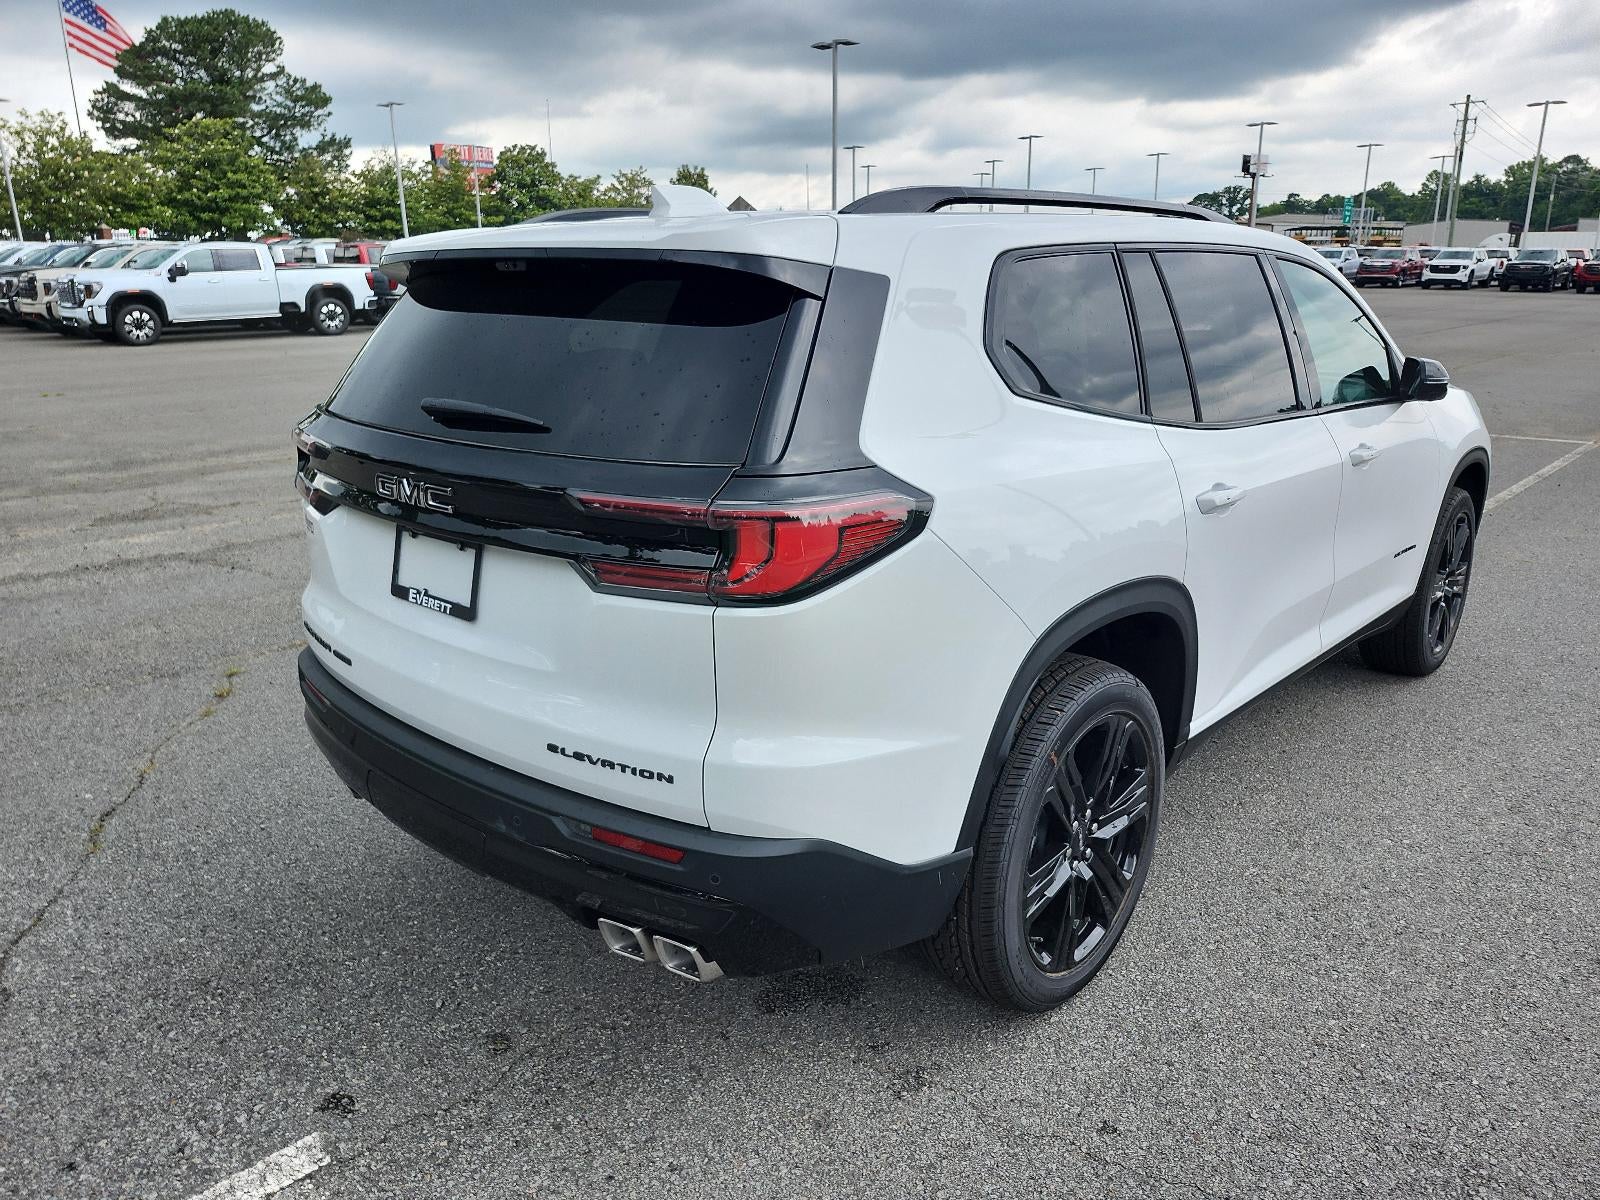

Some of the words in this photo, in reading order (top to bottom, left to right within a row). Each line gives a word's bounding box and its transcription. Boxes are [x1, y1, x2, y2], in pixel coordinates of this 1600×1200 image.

[375, 473, 453, 514] GMC
[408, 588, 453, 615] EVERETT
[546, 743, 675, 785] ELEVATION
